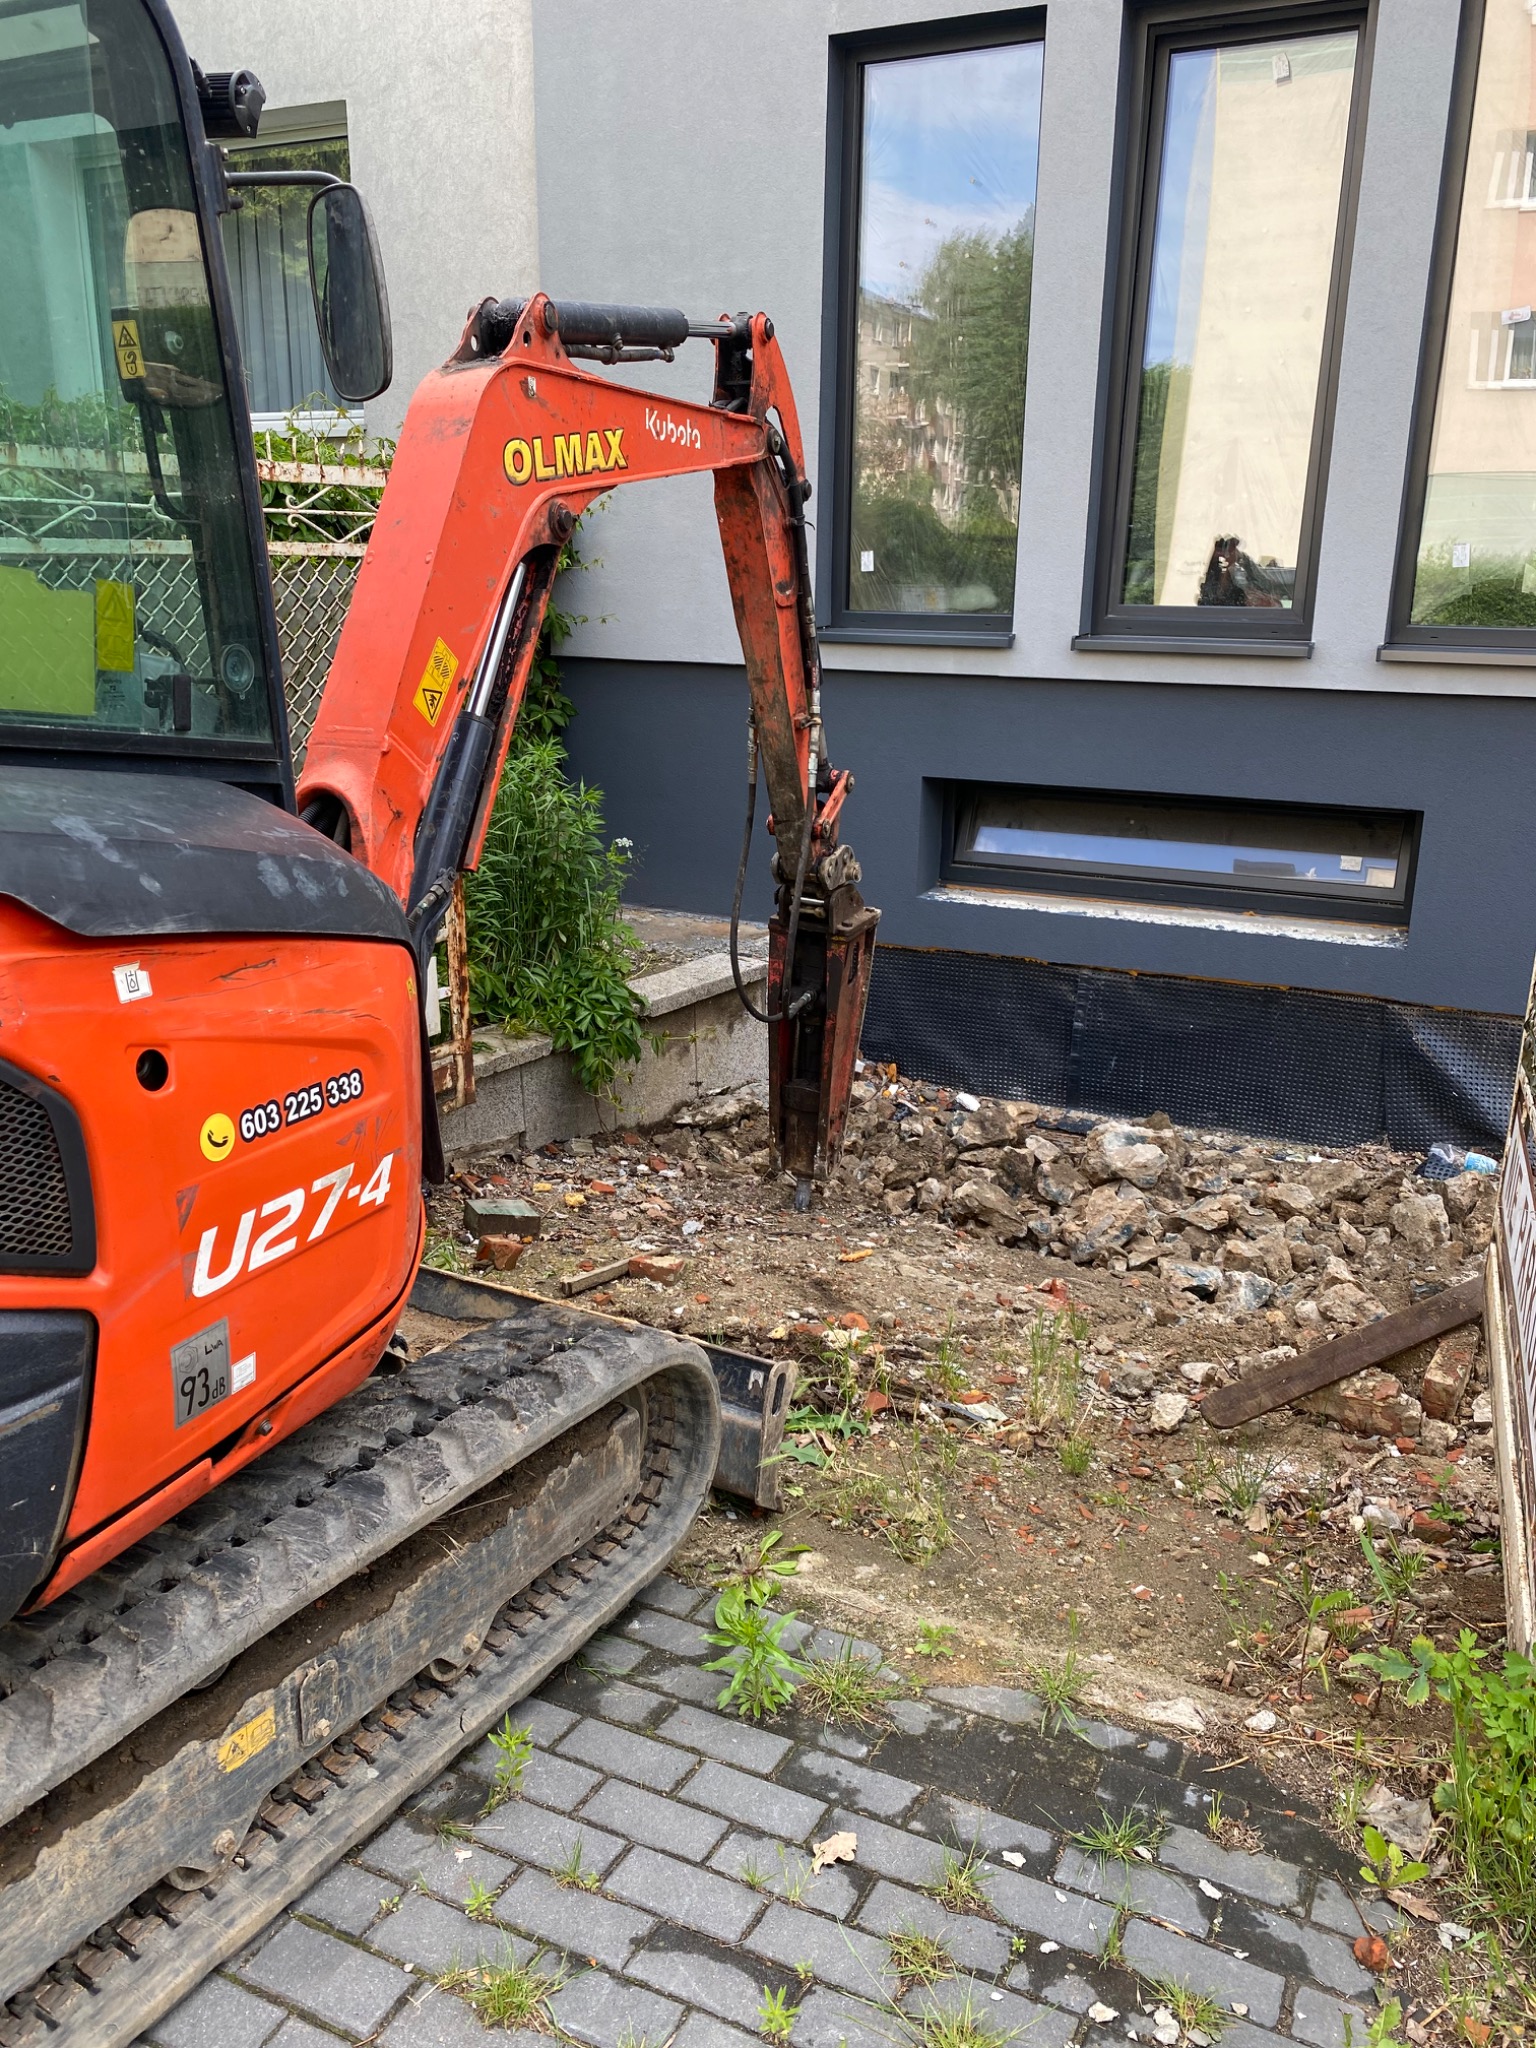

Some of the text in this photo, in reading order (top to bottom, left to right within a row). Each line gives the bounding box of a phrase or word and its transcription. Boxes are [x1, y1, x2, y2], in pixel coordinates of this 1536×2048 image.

[504, 428, 628, 485] OLMAX
[645, 408, 701, 449] Kubota
[240, 1070, 363, 1142] 603 225 338
[191, 1152, 394, 1298] U27-4
